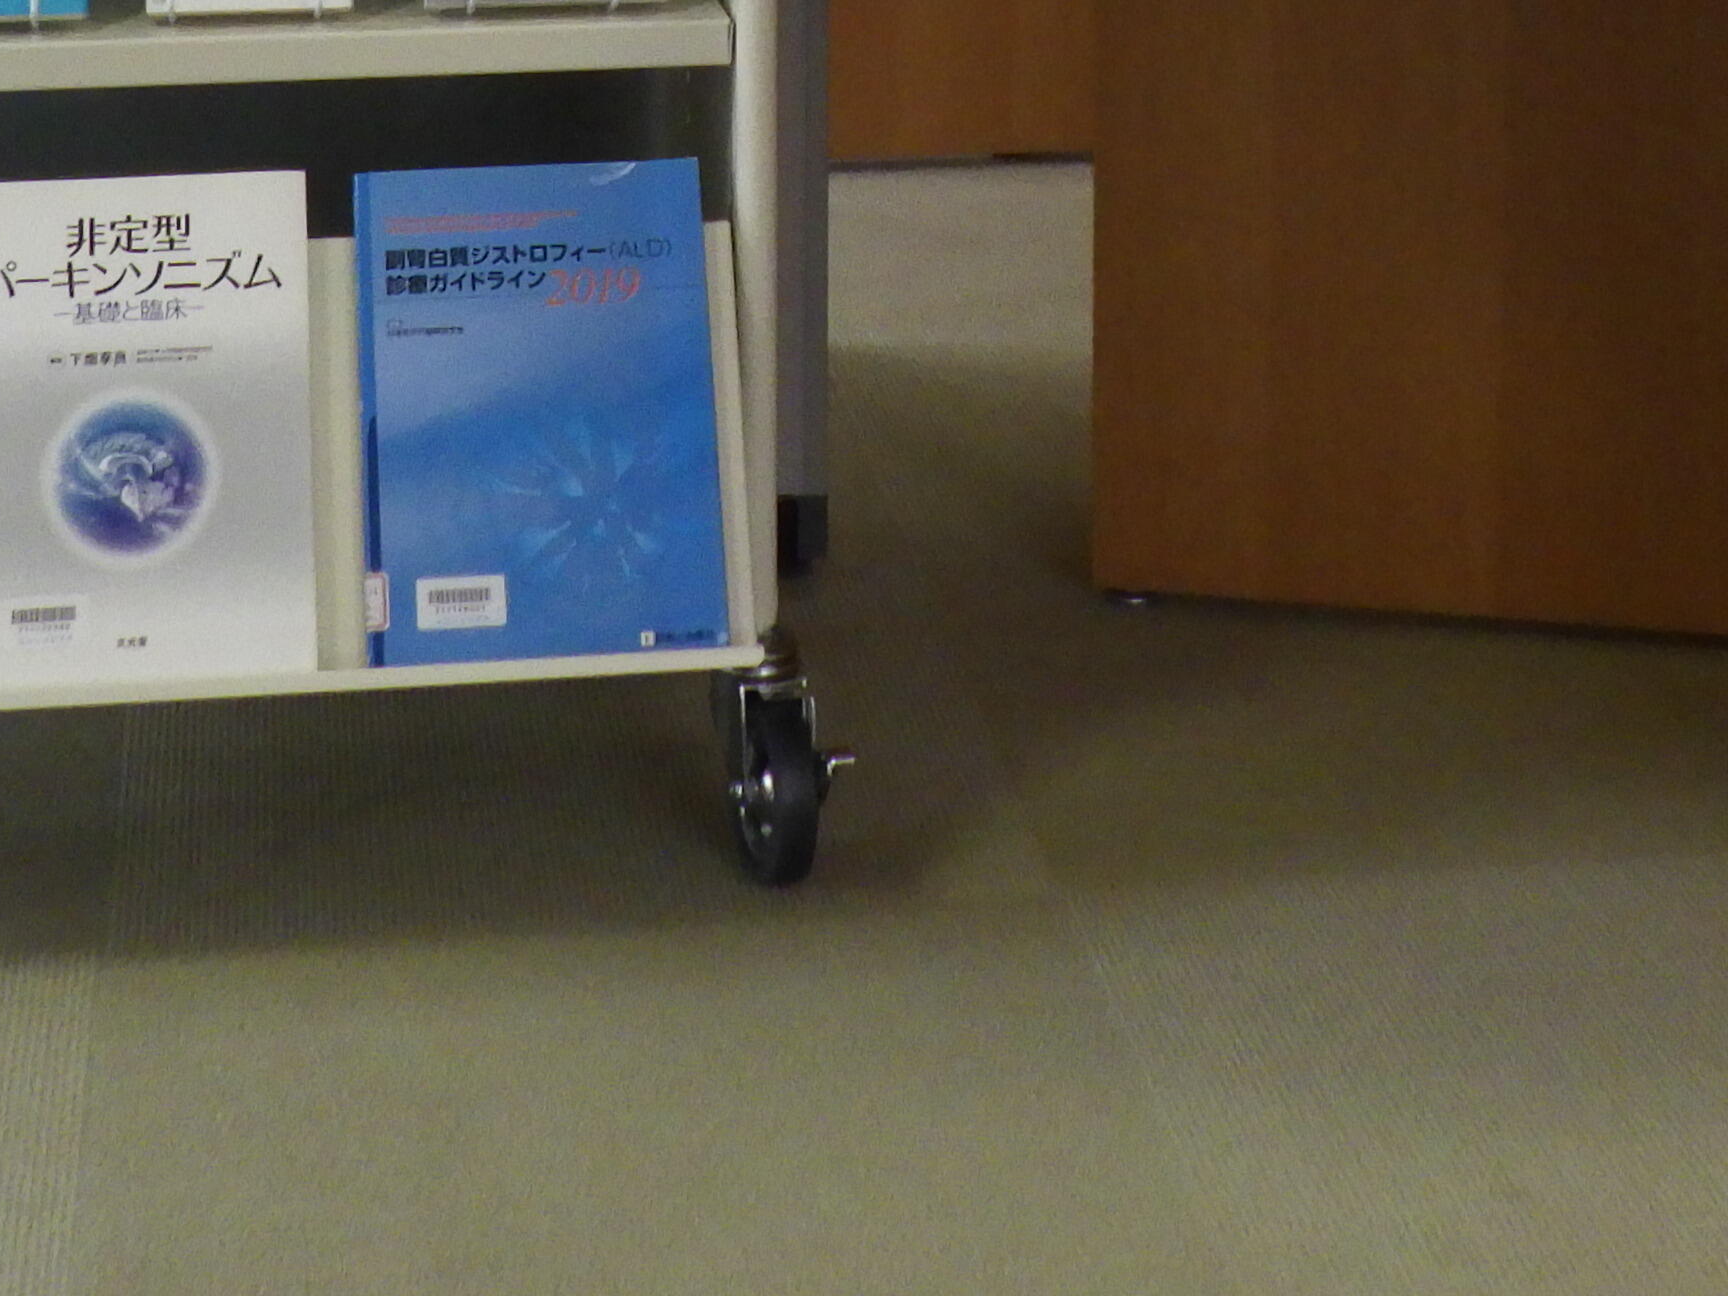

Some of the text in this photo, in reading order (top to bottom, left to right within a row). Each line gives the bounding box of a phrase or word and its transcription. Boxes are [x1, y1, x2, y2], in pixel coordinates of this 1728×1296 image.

[65, 213, 192, 257] 非定型
[385, 266, 642, 306] 診療ガイドライン 2019
